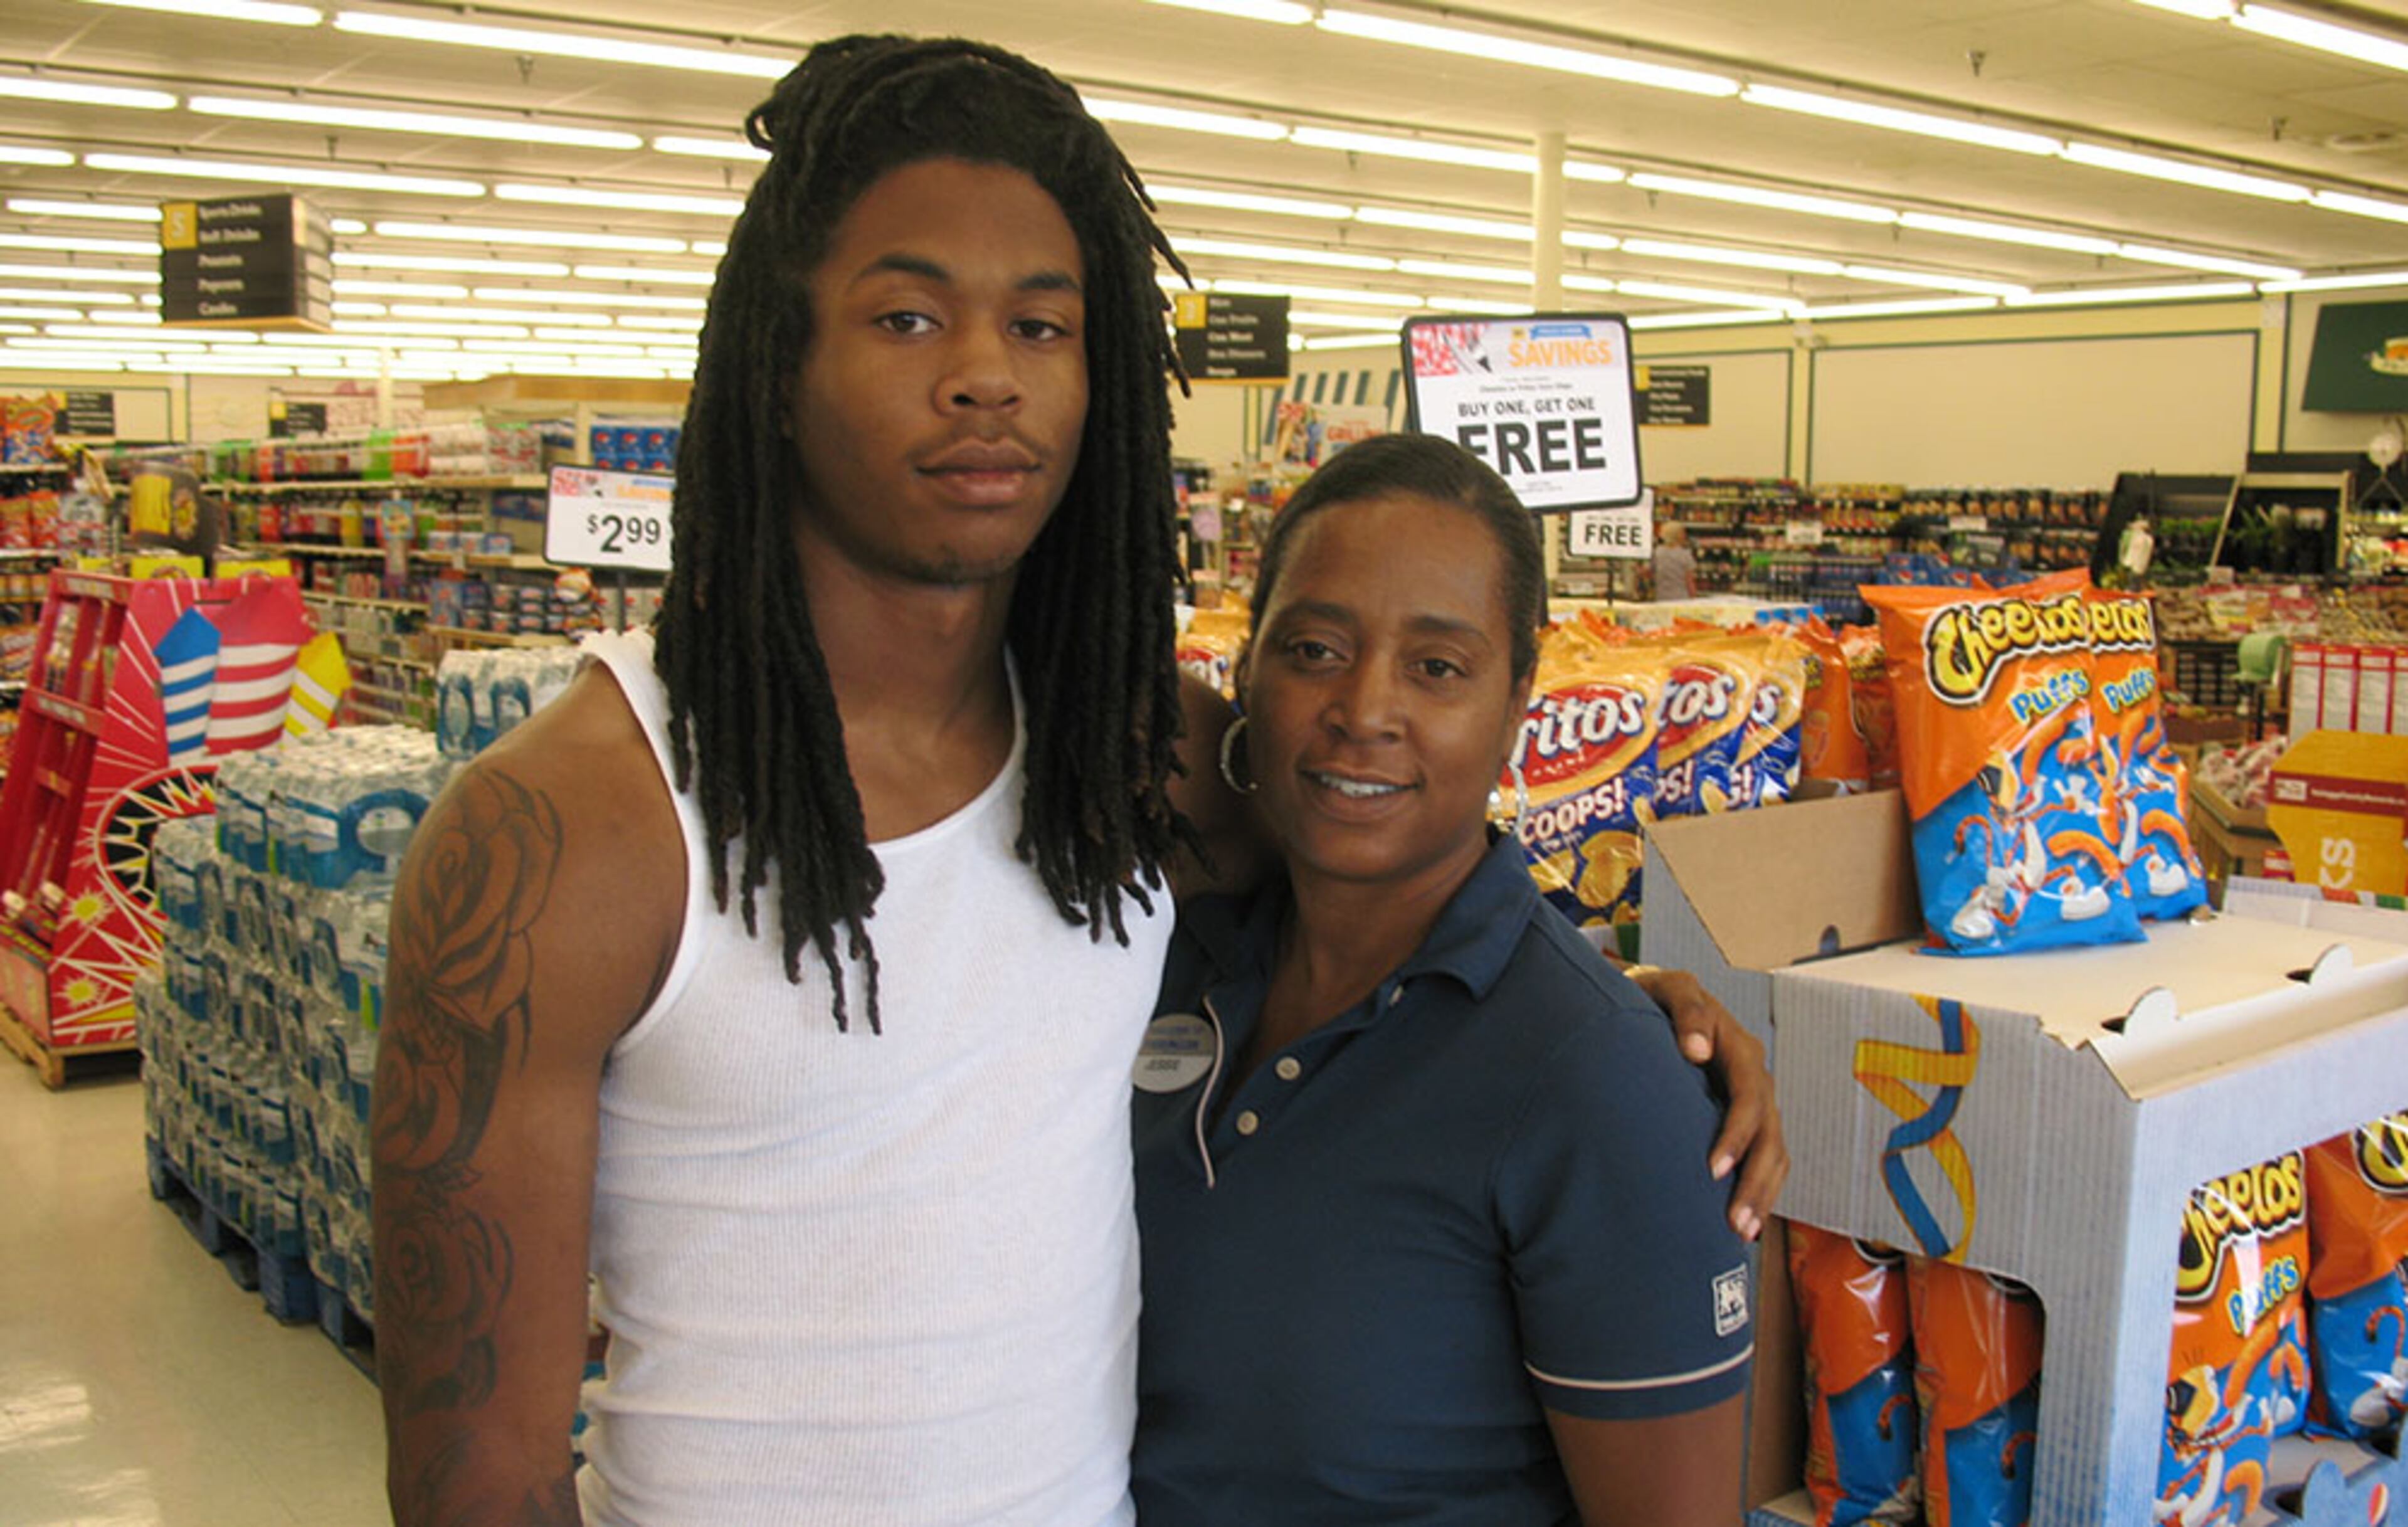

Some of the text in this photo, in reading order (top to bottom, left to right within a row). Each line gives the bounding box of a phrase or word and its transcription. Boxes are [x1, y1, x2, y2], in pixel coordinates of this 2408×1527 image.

[1508, 339, 1613, 367] SAVINGS
[1457, 396, 1595, 417] BUY ONE, GET ONE
[1457, 418, 1606, 475] FREE
[1584, 523, 1642, 547] FREE
[1928, 596, 2087, 697] Cheetos
[2009, 669, 2089, 722] Puffs
[2103, 669, 2155, 712] Puffs
[1509, 691, 1645, 766] ritos
[1518, 777, 1625, 846] COOPS!
